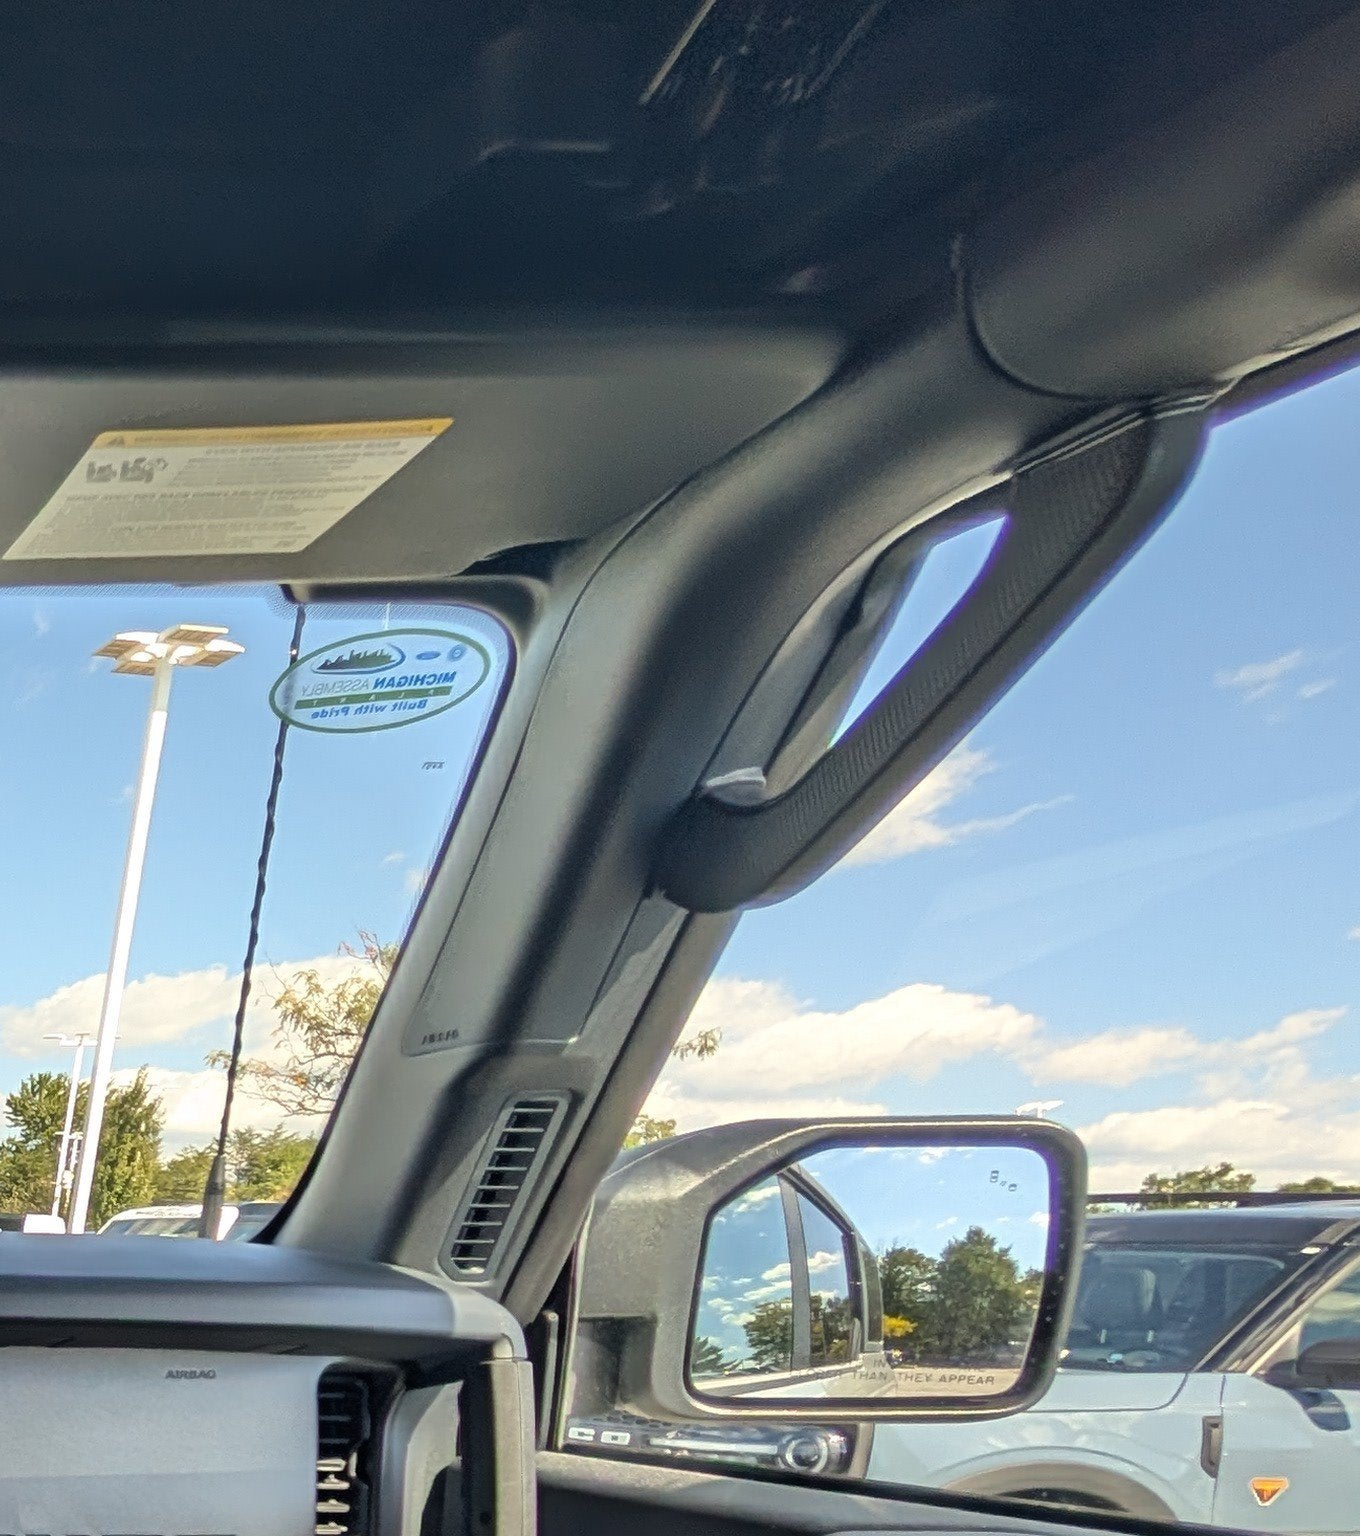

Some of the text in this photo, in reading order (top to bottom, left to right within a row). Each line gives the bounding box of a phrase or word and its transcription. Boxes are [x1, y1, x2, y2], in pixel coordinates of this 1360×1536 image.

[852, 1371, 888, 1381] THAN
[896, 1372, 933, 1383] THEY
[938, 1373, 995, 1386] APPEAR
